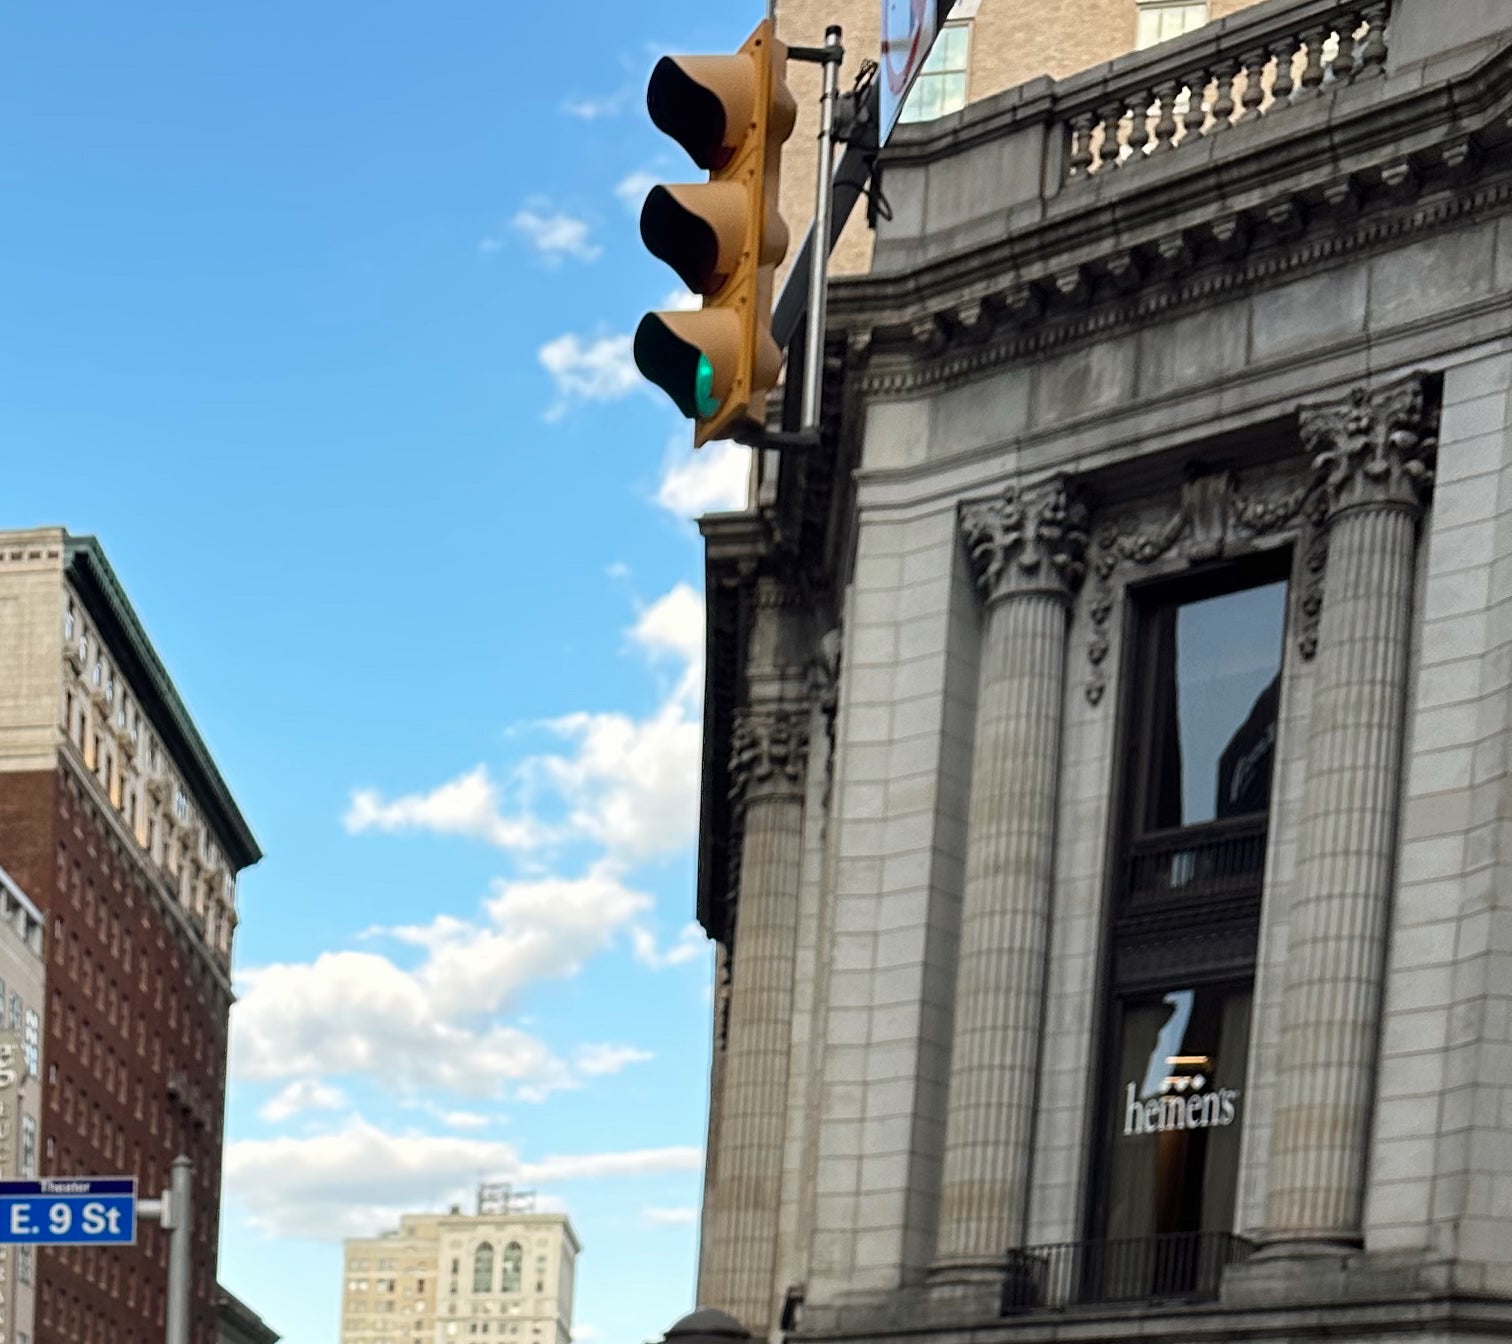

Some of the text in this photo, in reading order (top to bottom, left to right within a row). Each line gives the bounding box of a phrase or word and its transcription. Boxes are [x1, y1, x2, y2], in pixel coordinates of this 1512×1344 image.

[10, 1202, 121, 1235] E. 9 St
